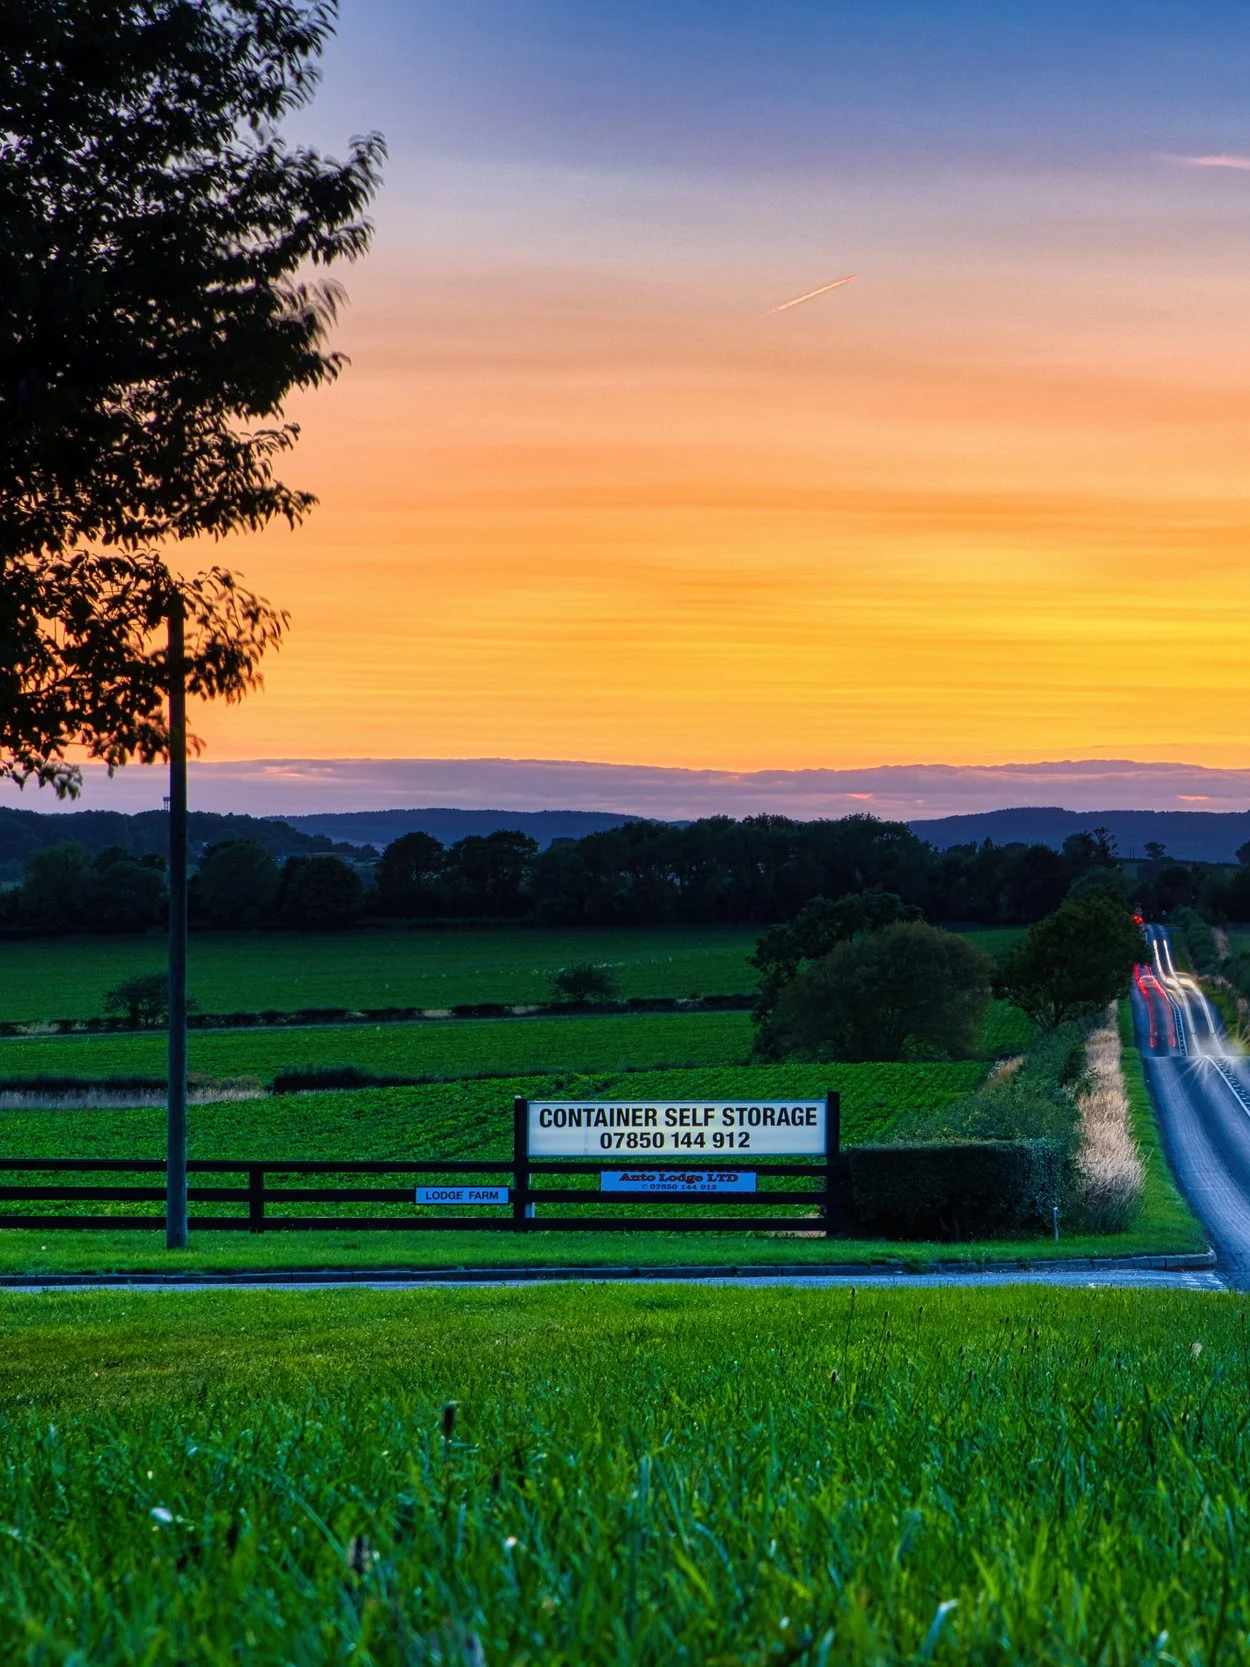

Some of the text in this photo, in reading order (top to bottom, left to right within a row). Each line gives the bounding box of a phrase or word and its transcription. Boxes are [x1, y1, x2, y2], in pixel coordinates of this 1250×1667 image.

[539, 1106, 817, 1128] CONTAINER SELF STORAGE
[600, 1131, 750, 1149] 07850 144 912
[619, 1173, 739, 1184] Auto Lodge LTD
[425, 1191, 499, 1200] LODGE FARM
